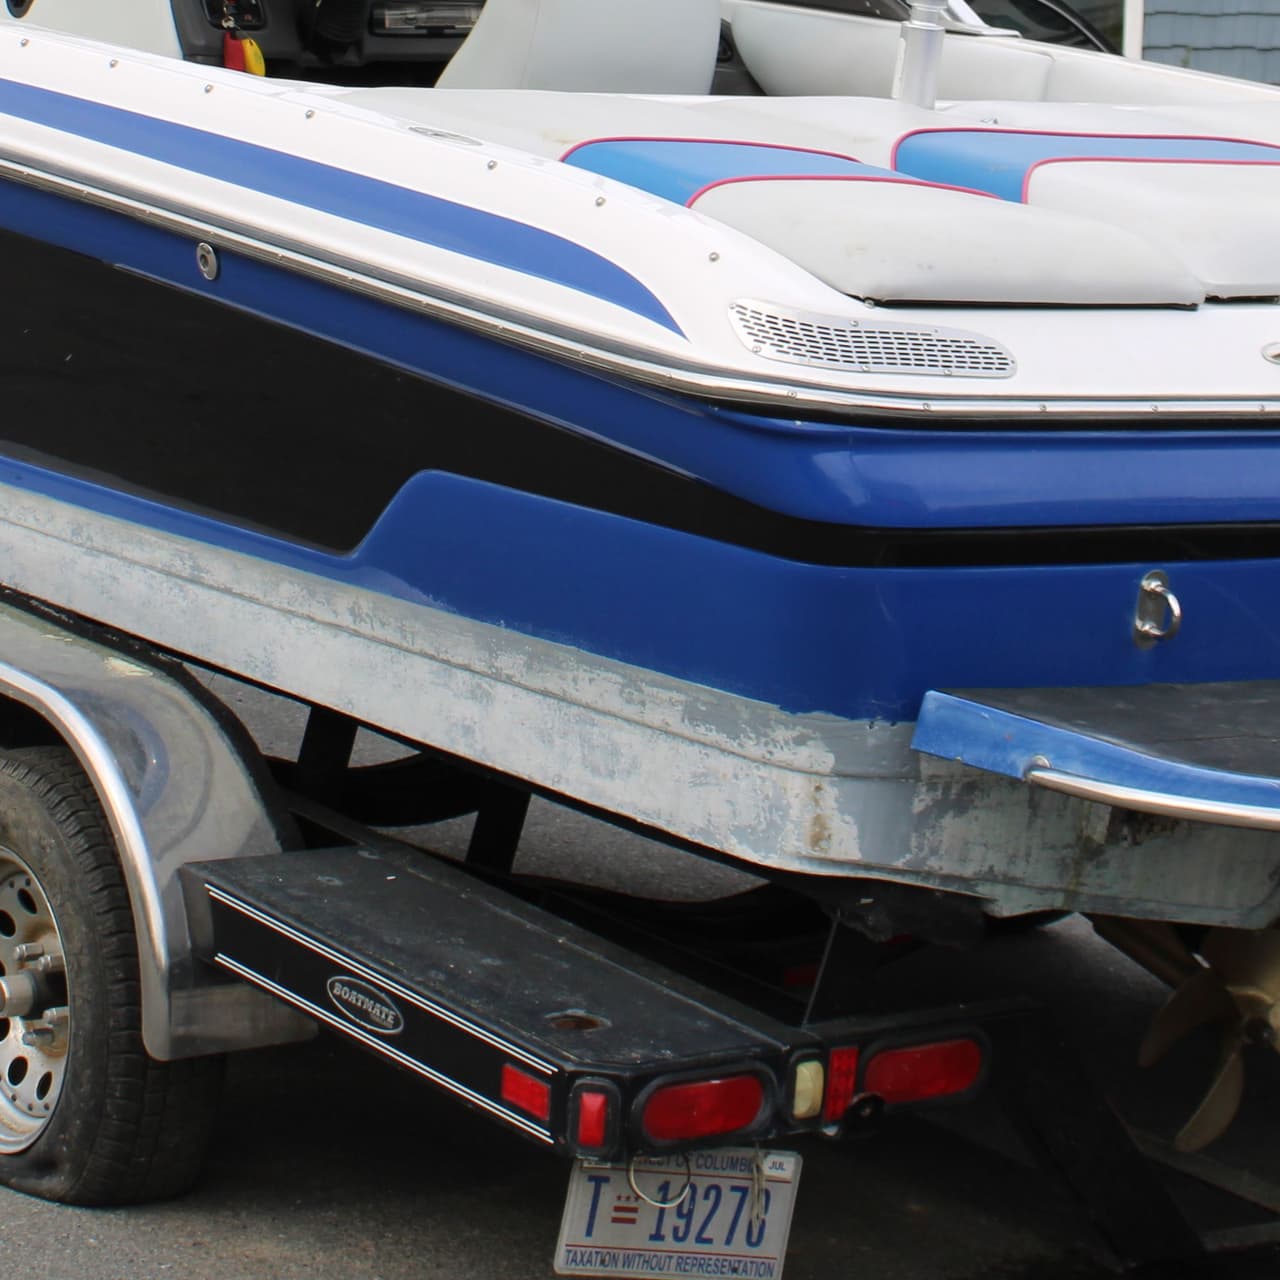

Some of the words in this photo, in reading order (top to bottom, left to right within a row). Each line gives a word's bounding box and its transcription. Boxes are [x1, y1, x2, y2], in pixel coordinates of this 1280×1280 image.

[333, 982, 396, 1024] BOATMATE
[696, 1153, 761, 1173] COLUMBI
[768, 1160, 785, 1171] JUL
[584, 1175, 610, 1238] T
[566, 1249, 619, 1269] TAXATION
[622, 1252, 673, 1273] WITHOUT
[675, 1255, 776, 1278] REPRESENTATION
